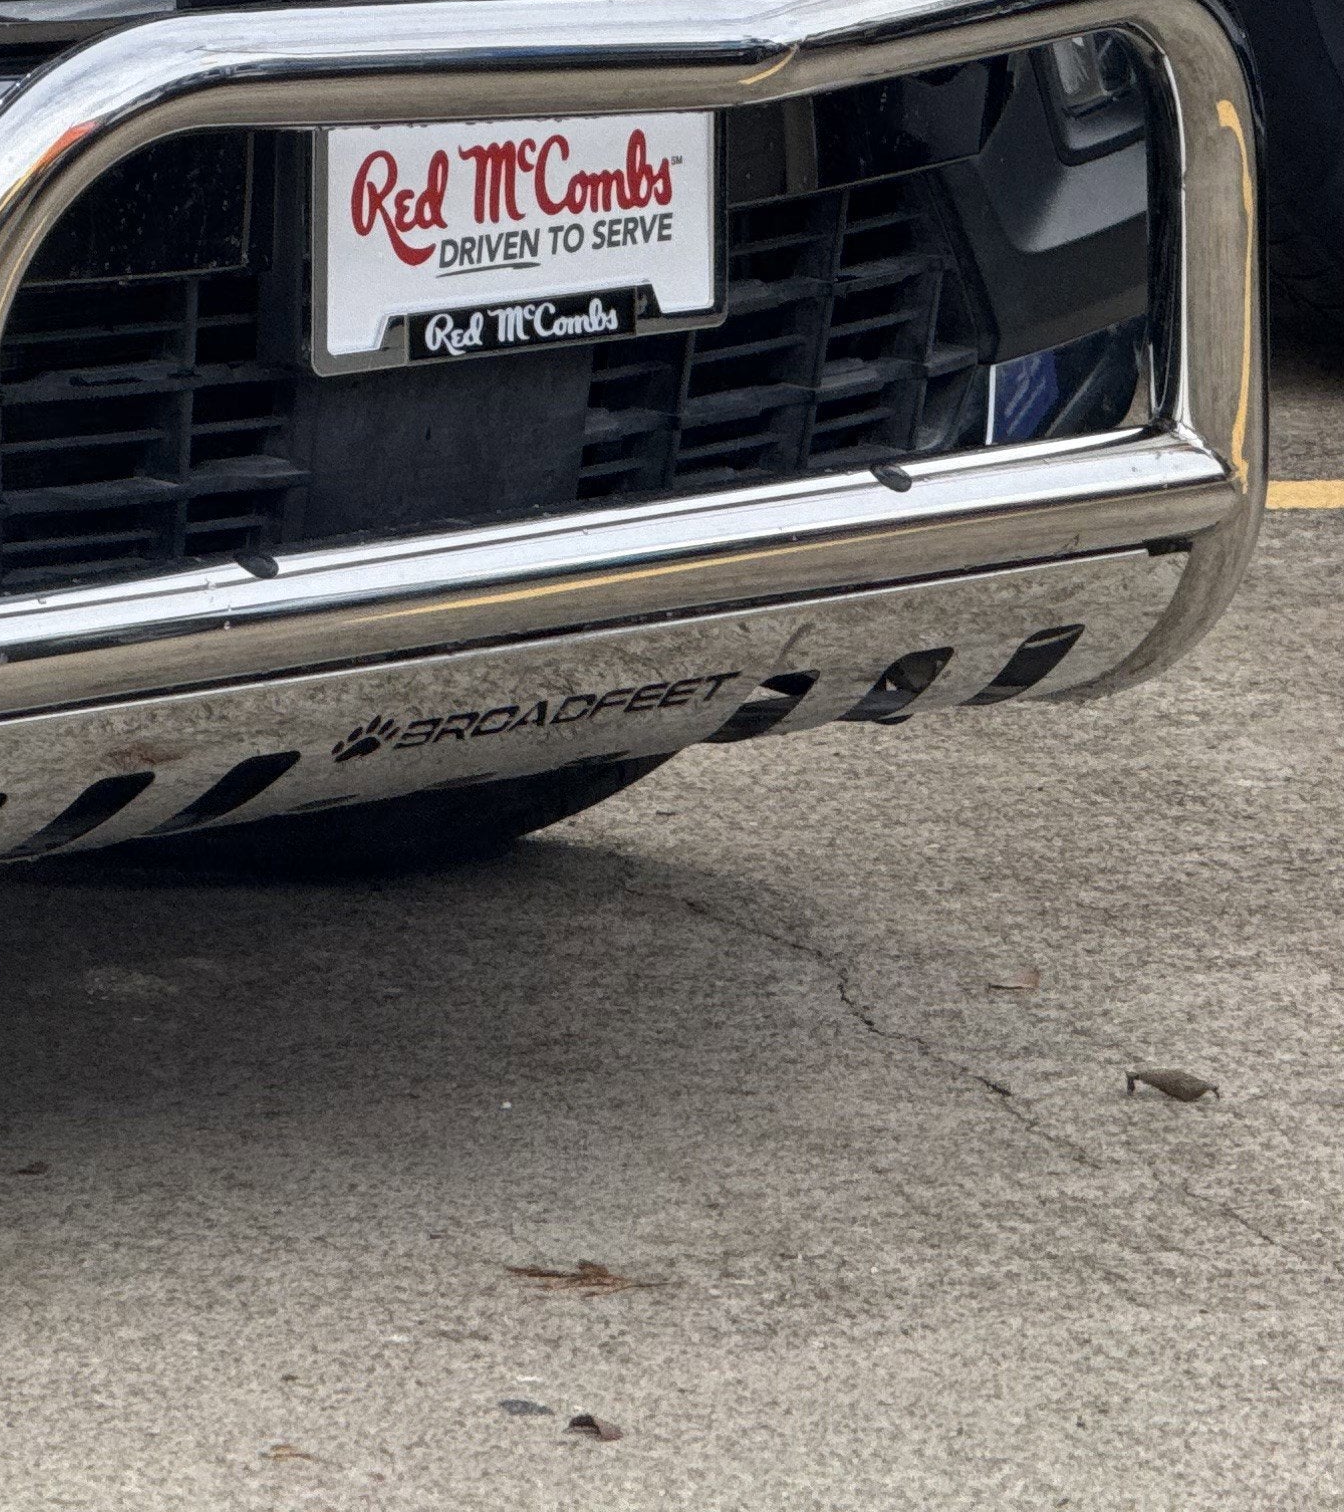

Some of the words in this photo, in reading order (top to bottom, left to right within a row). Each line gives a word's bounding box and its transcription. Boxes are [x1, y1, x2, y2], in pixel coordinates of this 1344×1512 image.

[350, 149, 449, 266] Red
[458, 129, 673, 224] McCombs
[438, 228, 540, 268] DRIVEN
[548, 223, 585, 255] TO
[591, 213, 673, 249] SERVE
[424, 313, 484, 356] Red
[486, 298, 619, 350] McCombs
[394, 671, 740, 749] BROADFEET
